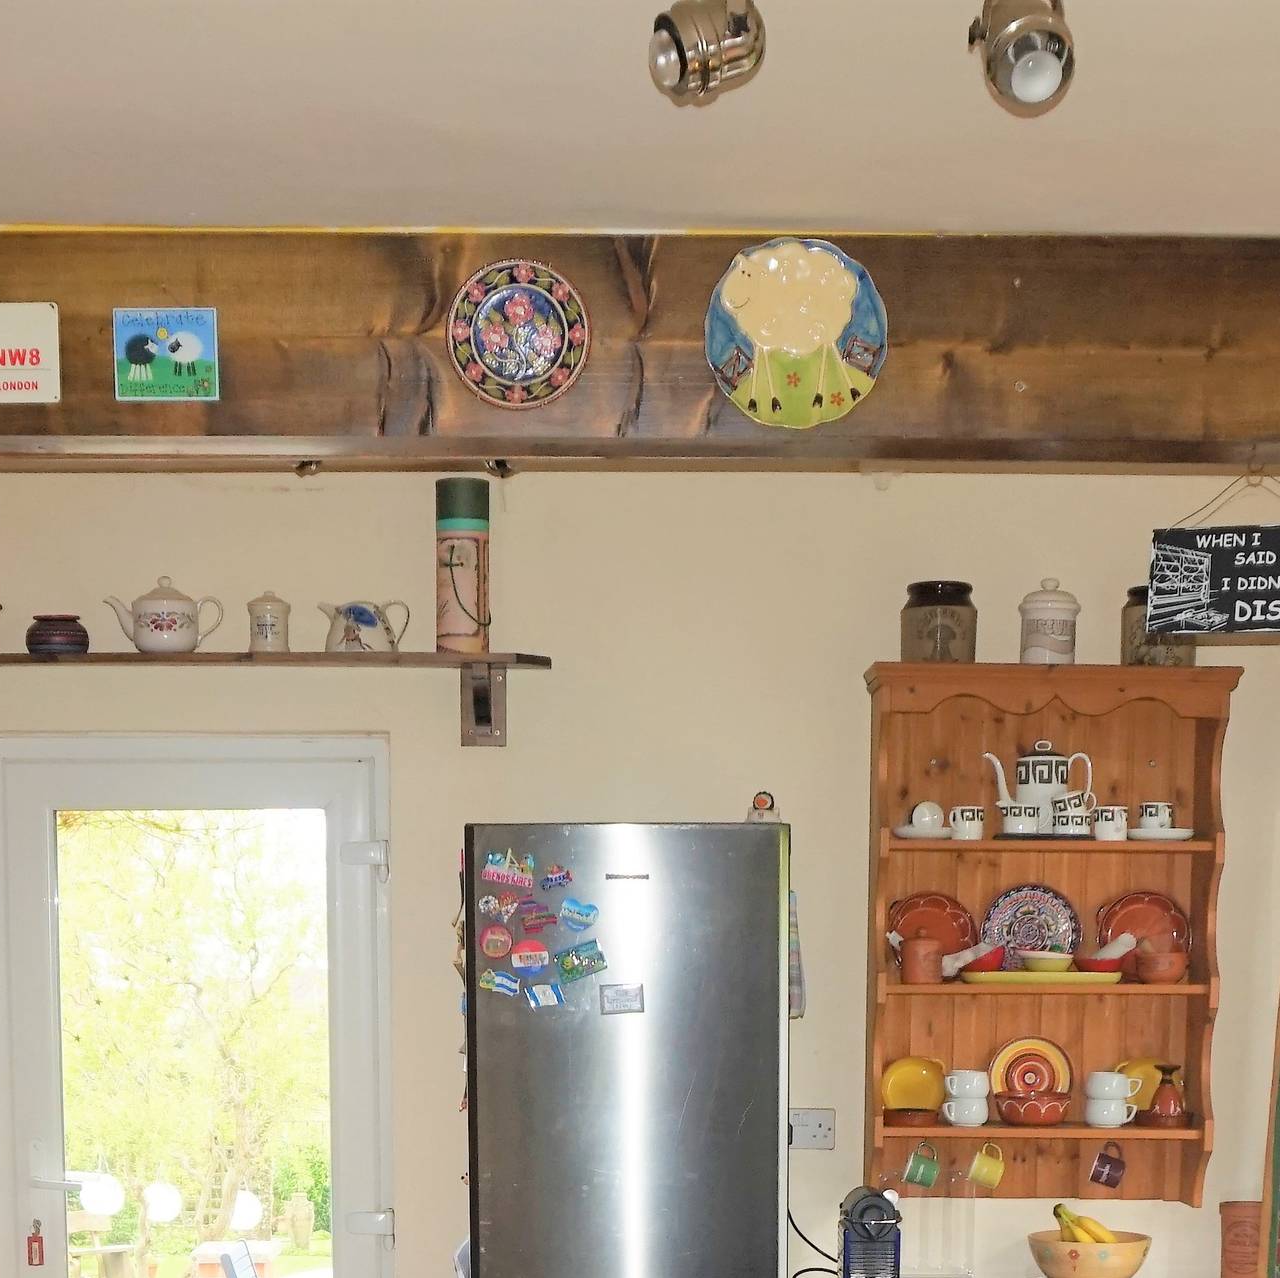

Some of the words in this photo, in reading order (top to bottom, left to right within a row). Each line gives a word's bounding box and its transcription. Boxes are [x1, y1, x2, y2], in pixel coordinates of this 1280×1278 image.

[1196, 533, 1246, 549] WHEN
[1251, 532, 1261, 547] I
[1234, 550, 1277, 566] SAID
[1221, 577, 1231, 591] I
